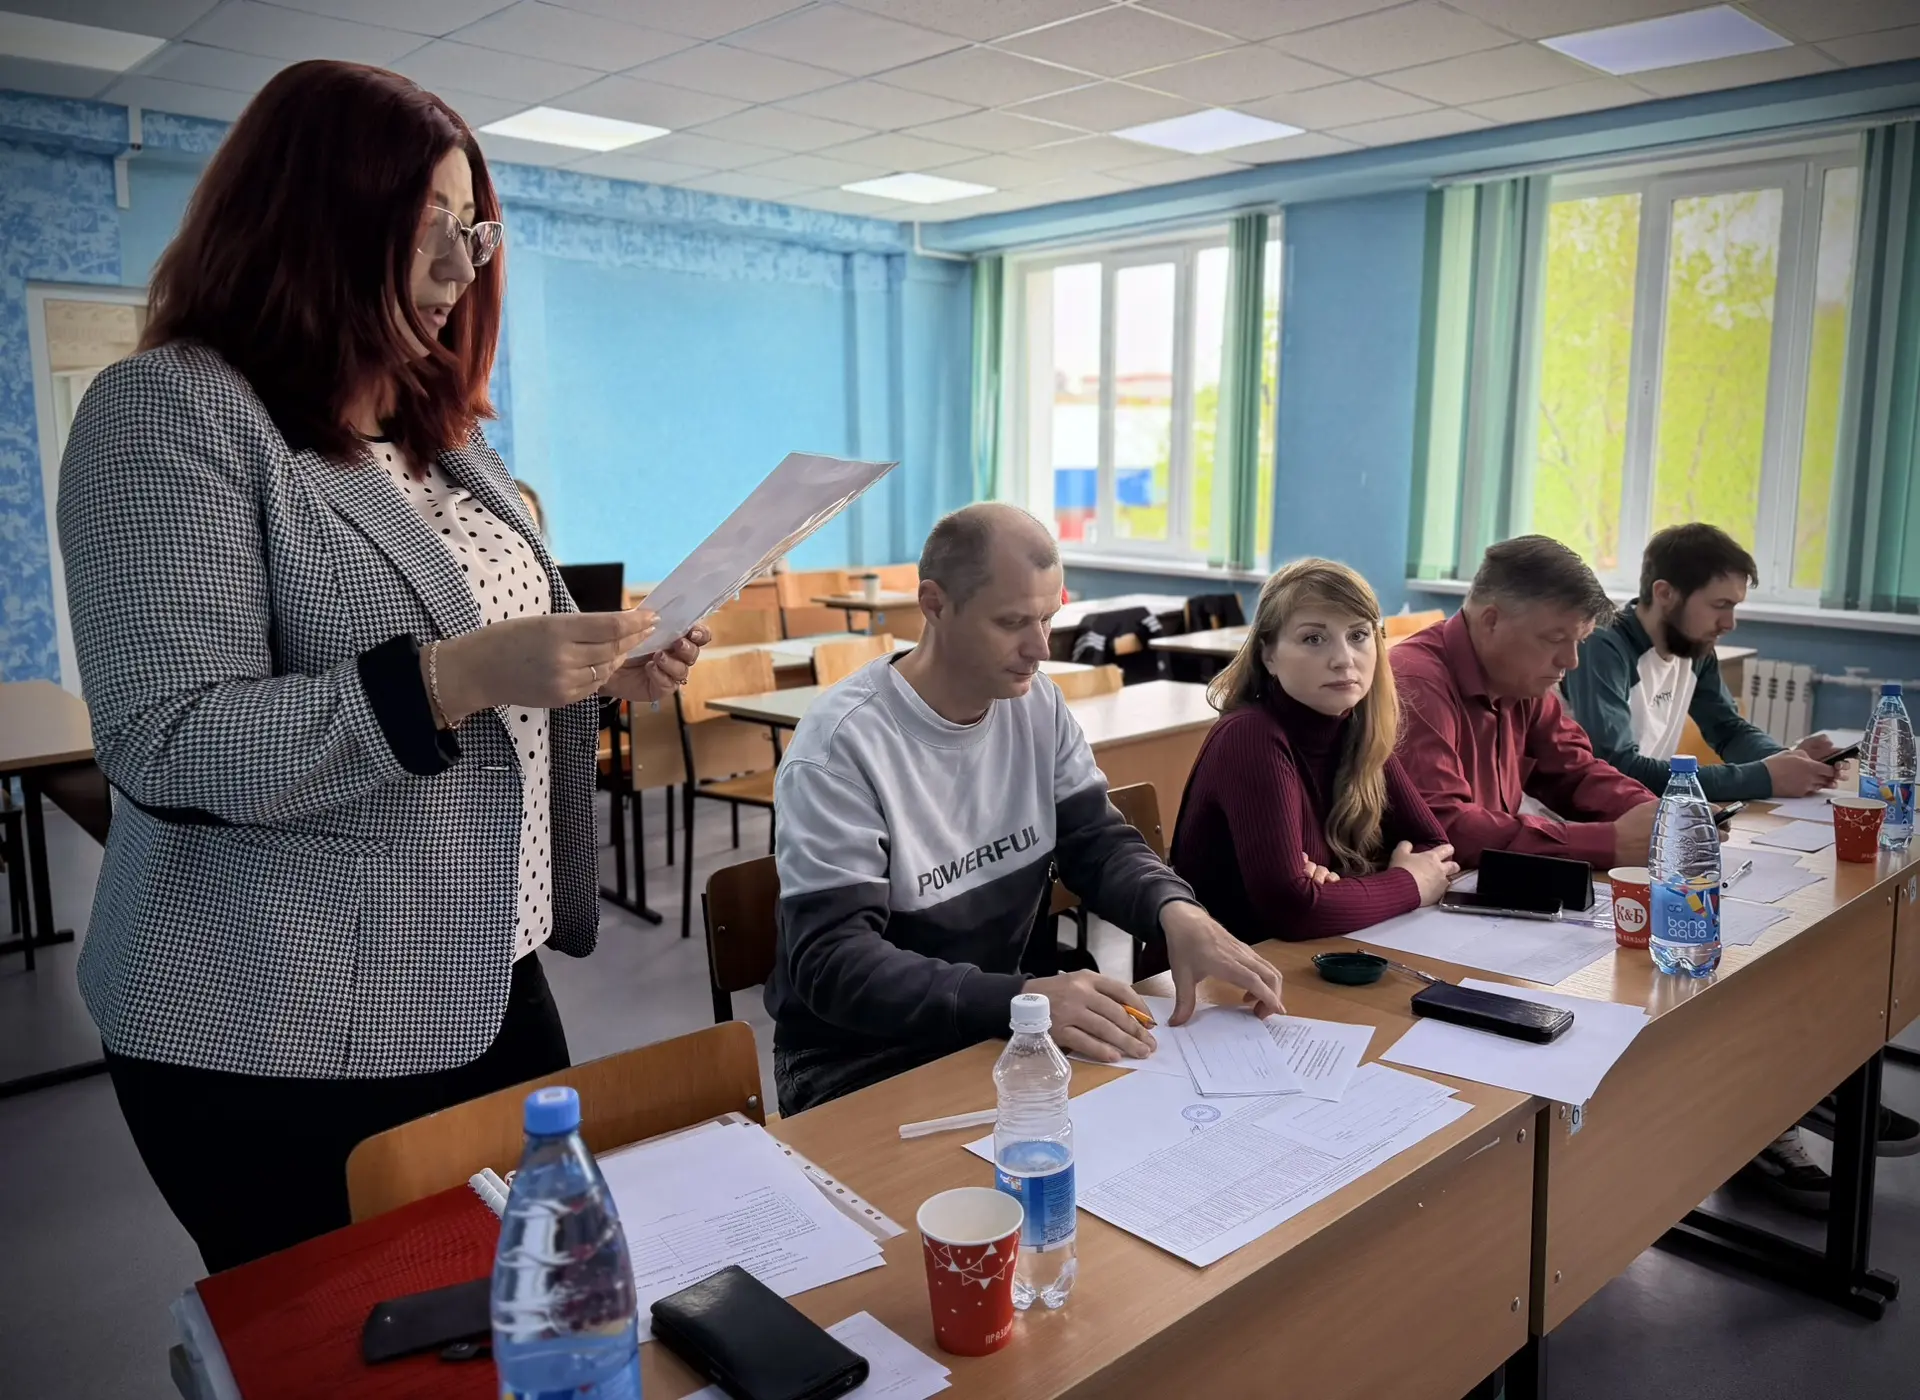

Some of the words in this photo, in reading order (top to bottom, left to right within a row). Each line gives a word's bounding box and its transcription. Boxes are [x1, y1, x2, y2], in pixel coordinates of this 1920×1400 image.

[917, 825, 1040, 897] POWERFUL
[1616, 904, 1644, 924] К&Б
[1667, 928, 1707, 940] aqua
[1571, 1105, 1580, 1125] 6
